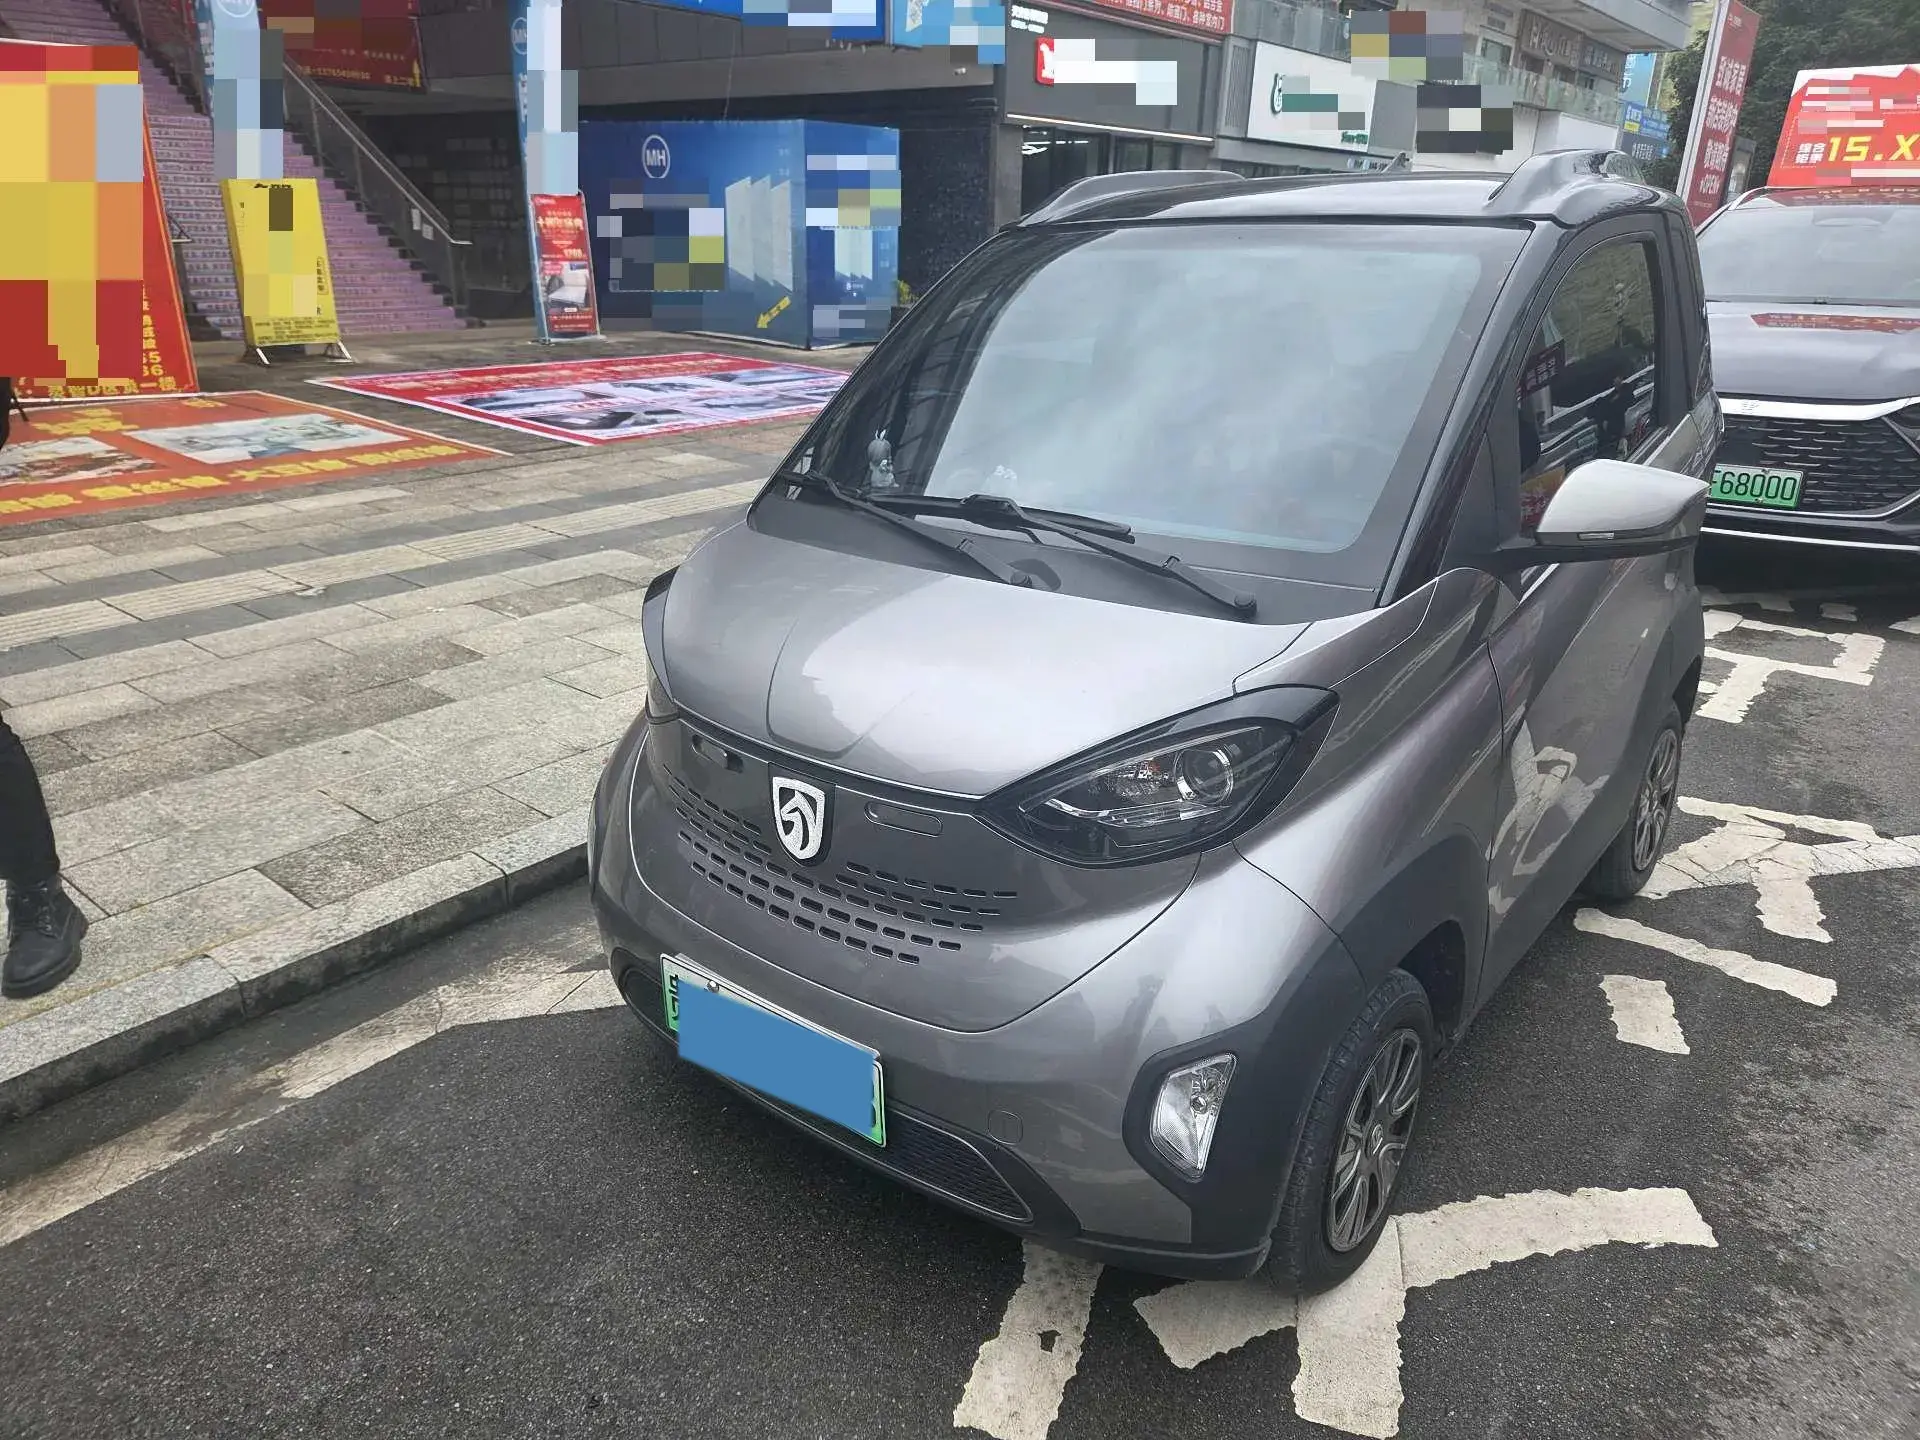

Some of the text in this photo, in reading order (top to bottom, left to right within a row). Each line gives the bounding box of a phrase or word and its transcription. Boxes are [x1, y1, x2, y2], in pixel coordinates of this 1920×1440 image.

[646, 149, 667, 166] MH
[1828, 134, 1920, 161] 15.X
[1713, 470, 1797, 501] 68000
